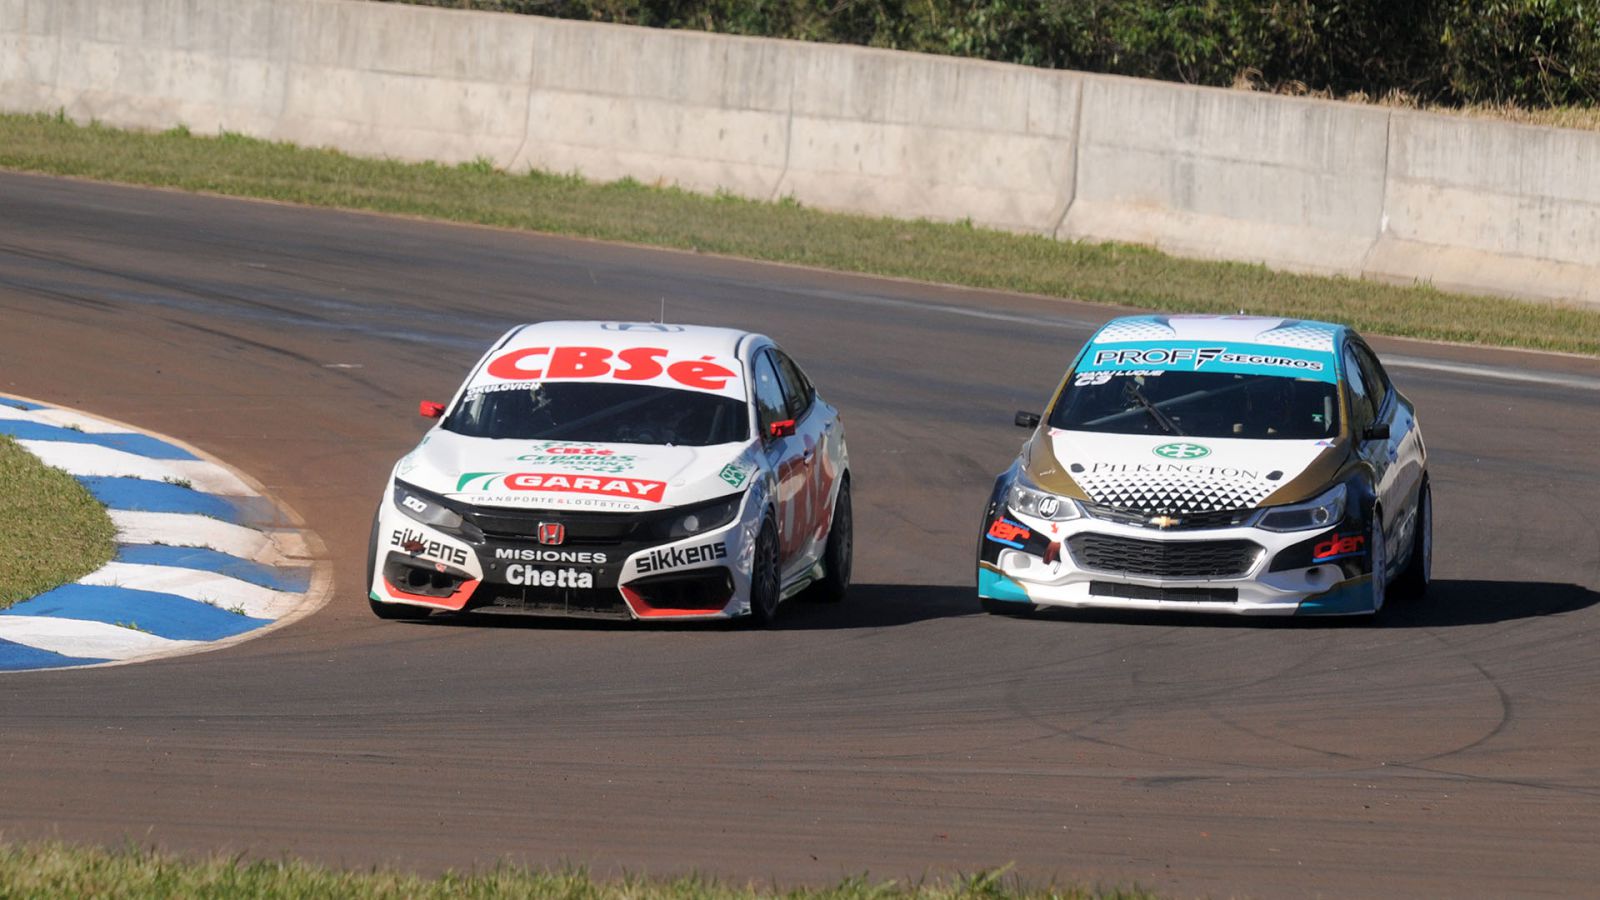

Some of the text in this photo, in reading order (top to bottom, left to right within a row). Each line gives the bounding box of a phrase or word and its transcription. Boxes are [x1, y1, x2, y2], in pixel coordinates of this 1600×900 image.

[487, 346, 737, 390] CBSé
[1094, 348, 1194, 366] PROF
[1223, 353, 1324, 371] SEGUROS
[1092, 461, 1259, 480] PILKINGTON
[514, 475, 660, 496] GARAY
[402, 495, 428, 513] 100
[495, 547, 607, 564] MISIONES
[635, 541, 727, 574] sikkens
[505, 564, 593, 589] Chetta
